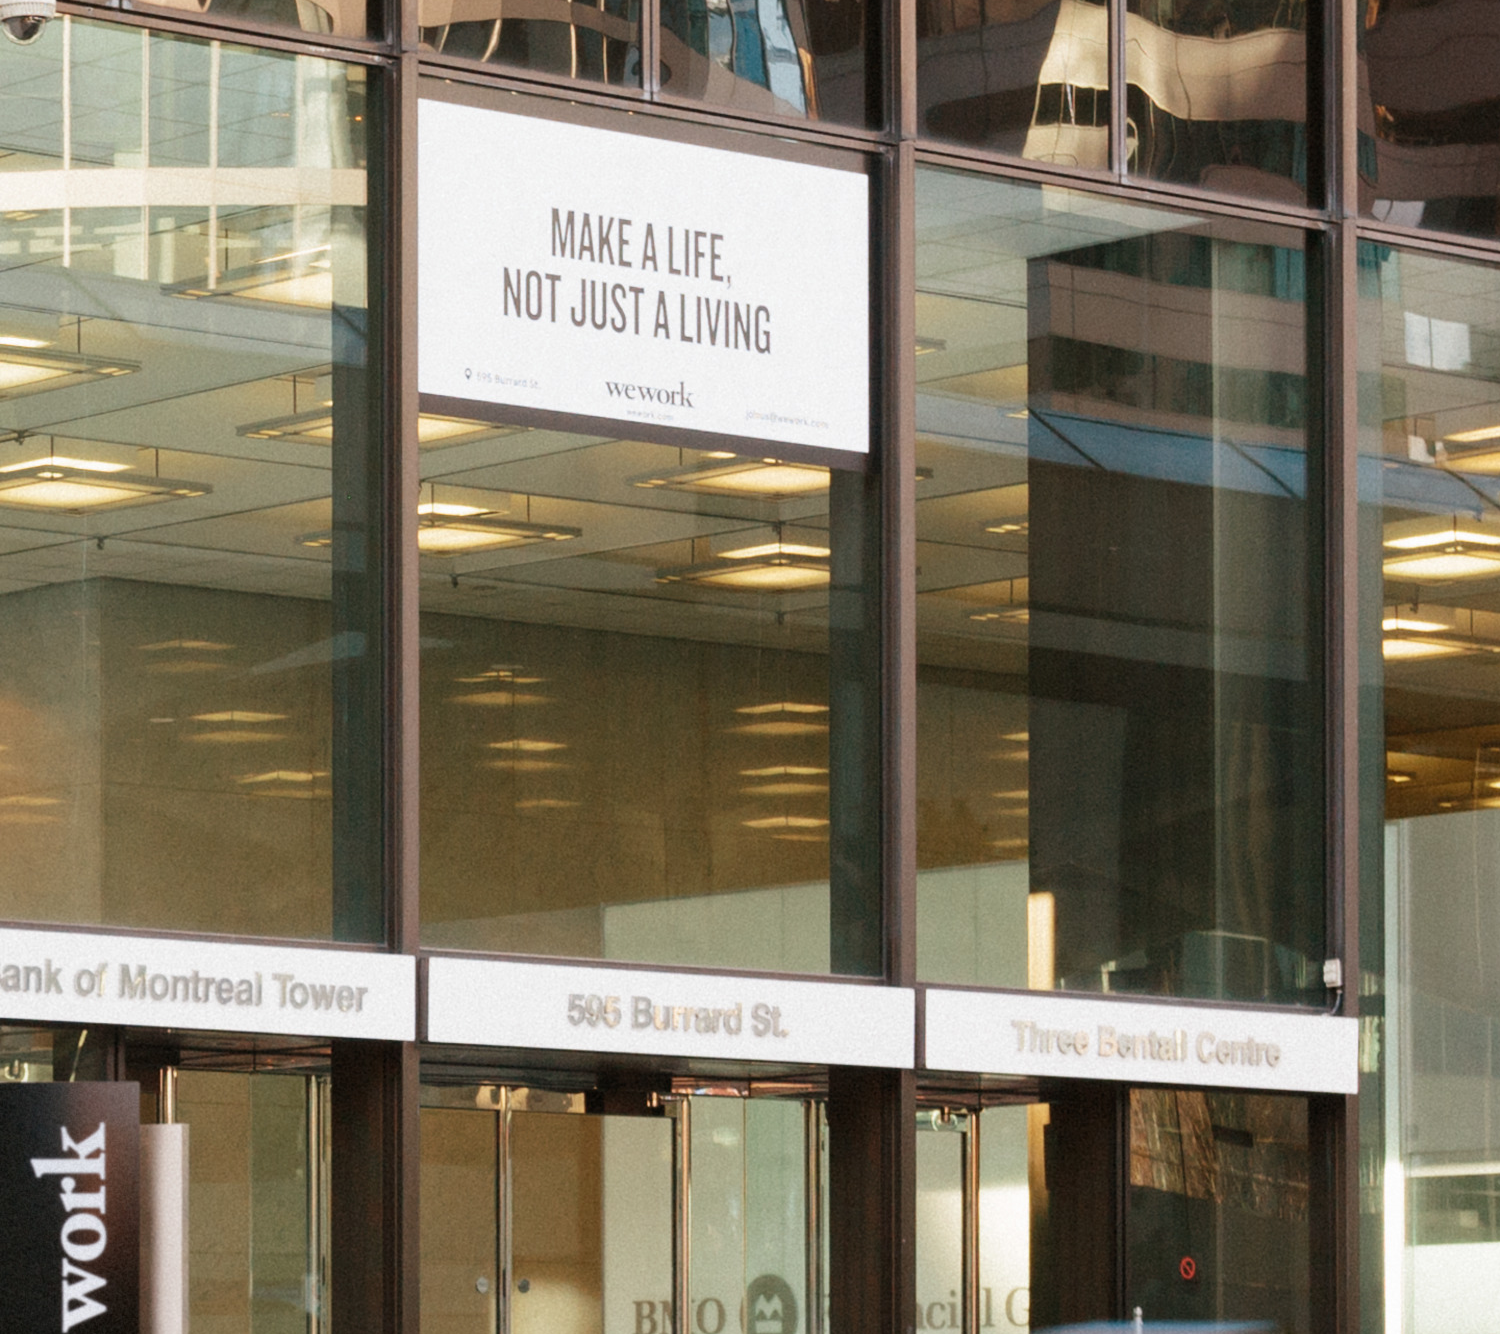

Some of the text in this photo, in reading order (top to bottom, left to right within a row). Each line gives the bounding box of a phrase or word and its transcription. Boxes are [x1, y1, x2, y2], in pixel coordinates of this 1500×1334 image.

[551, 207, 731, 289] MAKE A LIFE,
[503, 267, 771, 354] NOT JUST A LIVING
[605, 381, 694, 408] wework
[74, 961, 108, 998] of
[118, 963, 263, 1007] Montreal
[271, 971, 368, 1013] Tower
[567, 993, 789, 1038] 595 Burrard St.
[1011, 1020, 1281, 1068] Three Bentall Centre
